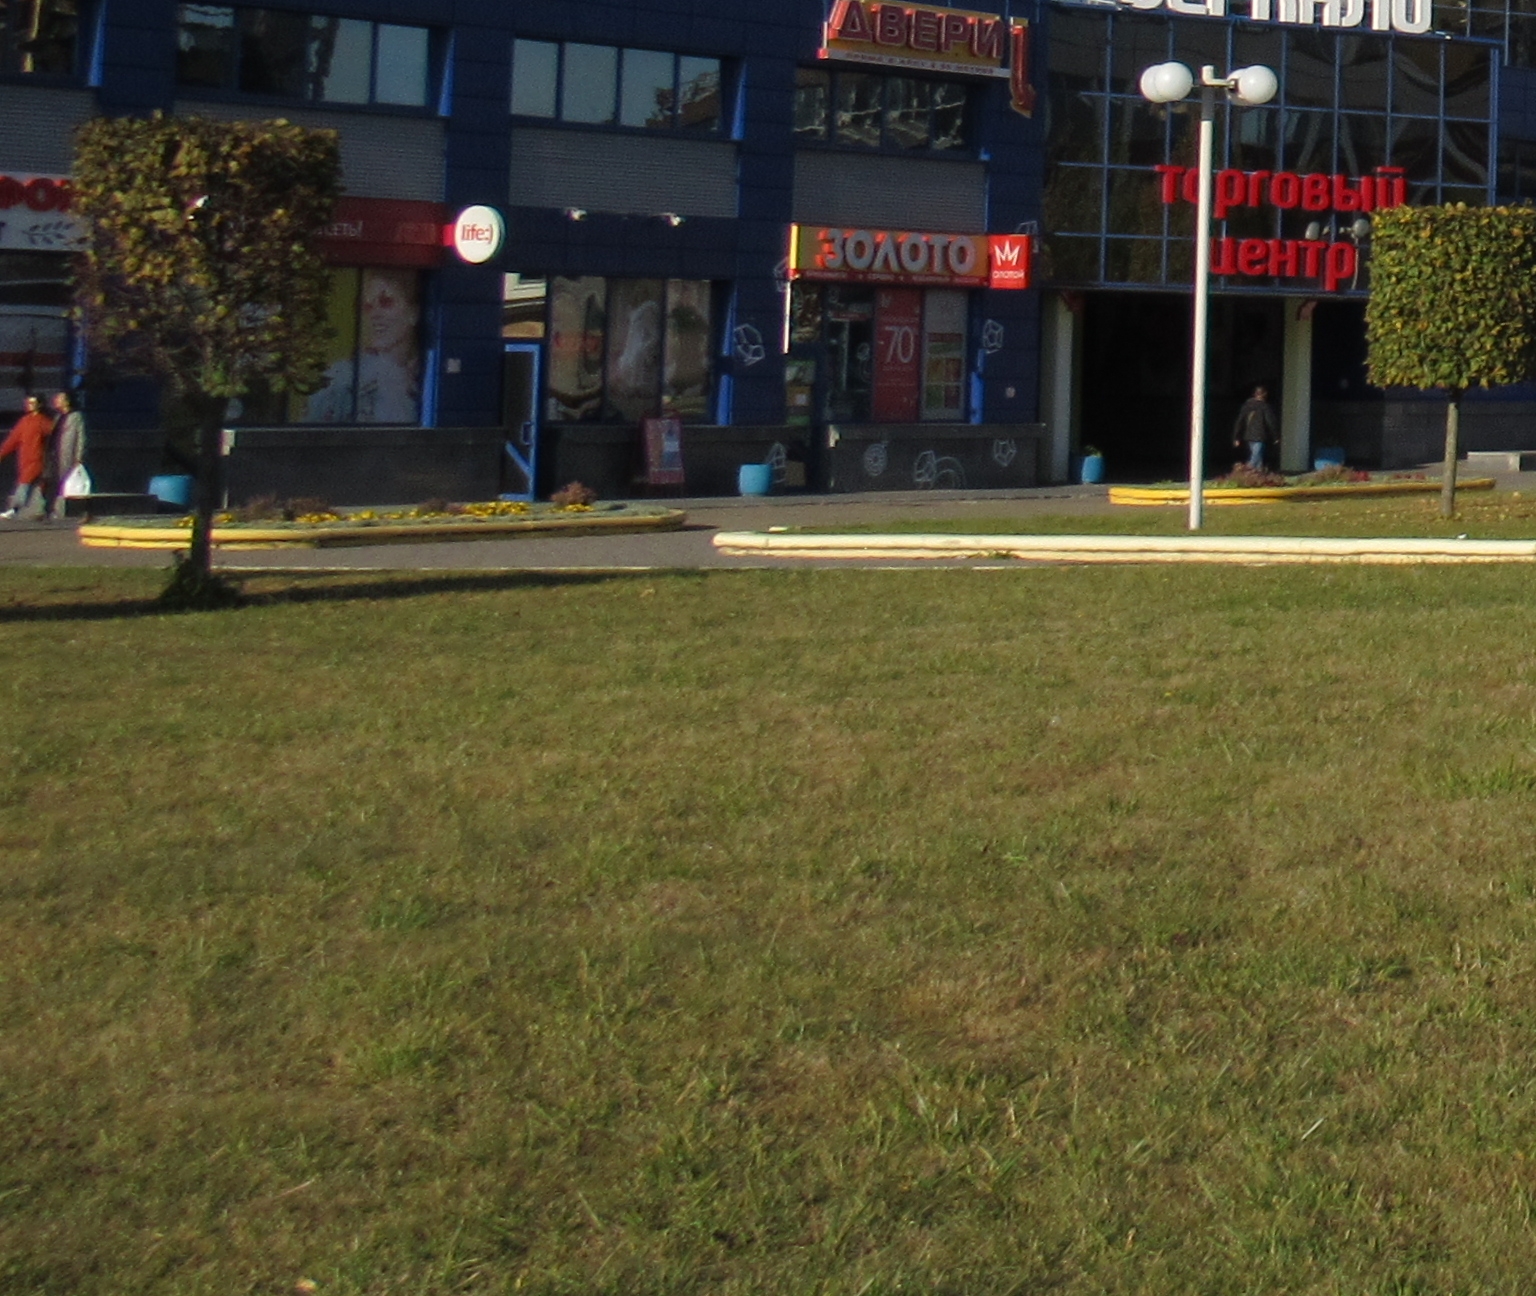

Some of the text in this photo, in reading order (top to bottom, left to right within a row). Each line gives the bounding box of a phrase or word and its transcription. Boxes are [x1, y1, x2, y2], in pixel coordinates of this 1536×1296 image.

[831, 0, 1005, 59] ДВЕРИ
[1155, 164, 1407, 219] торговый
[818, 228, 977, 274] ЗОЛОТО
[1208, 236, 1357, 291] центр
